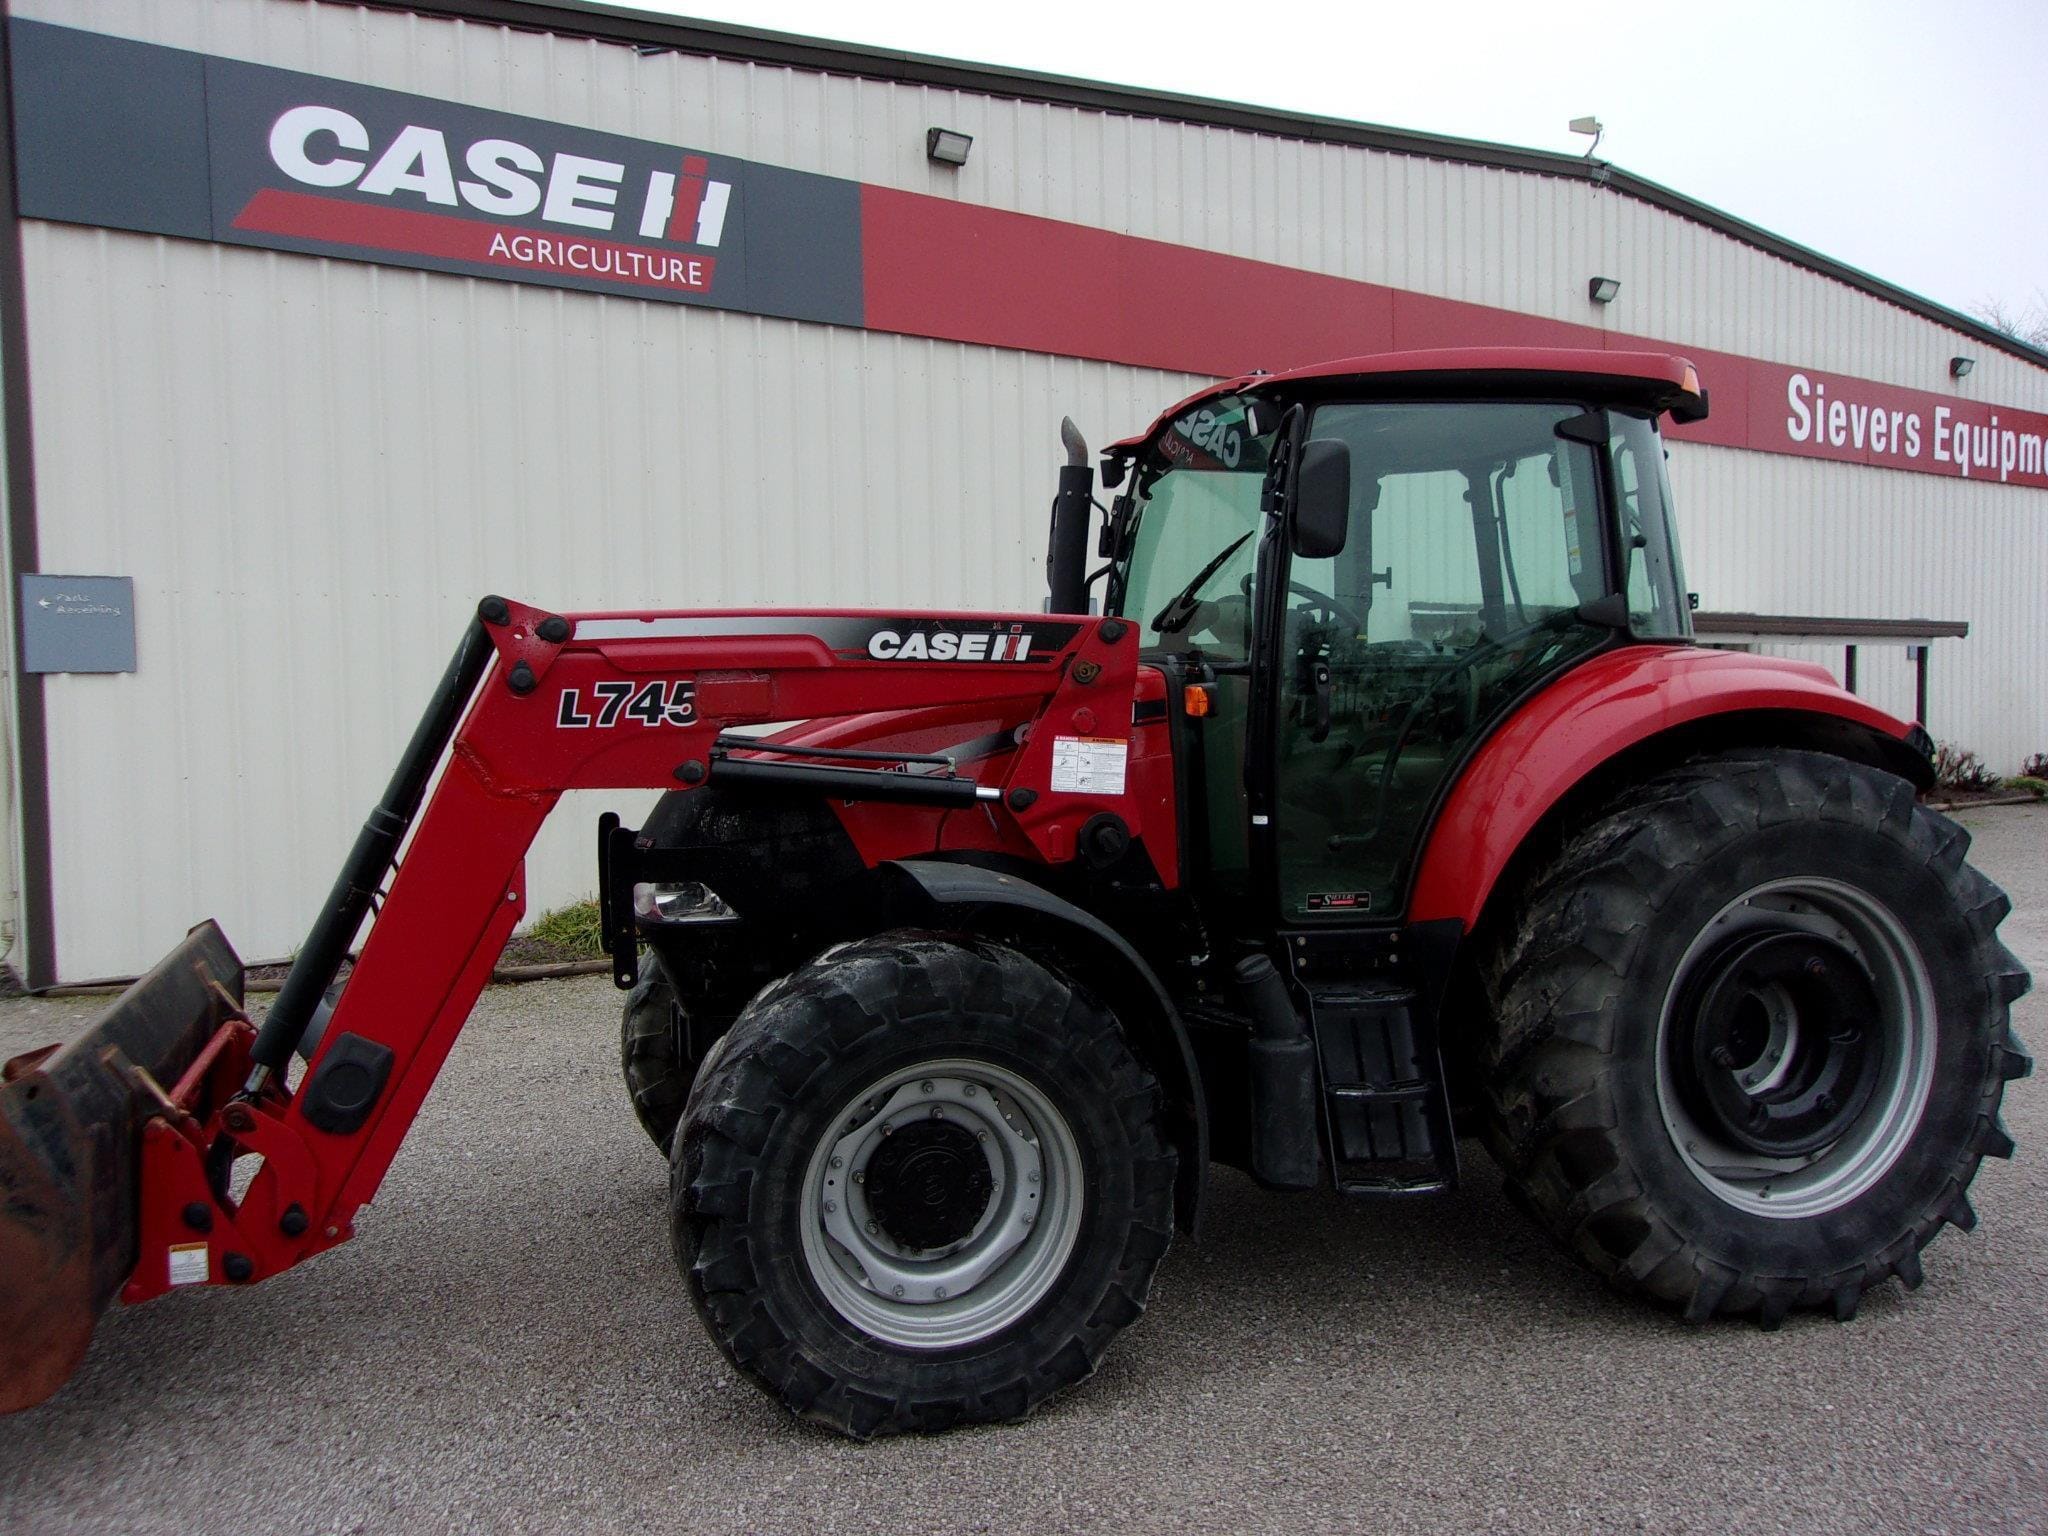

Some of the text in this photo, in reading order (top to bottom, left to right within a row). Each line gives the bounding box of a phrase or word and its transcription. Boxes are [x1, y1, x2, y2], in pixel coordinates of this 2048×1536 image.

[269, 105, 626, 231] CASE
[488, 232, 703, 286] AGRICULTURE
[1787, 373, 2048, 482] Sievers Equipm
[868, 630, 990, 661] CASE
[556, 680, 699, 728] L745
